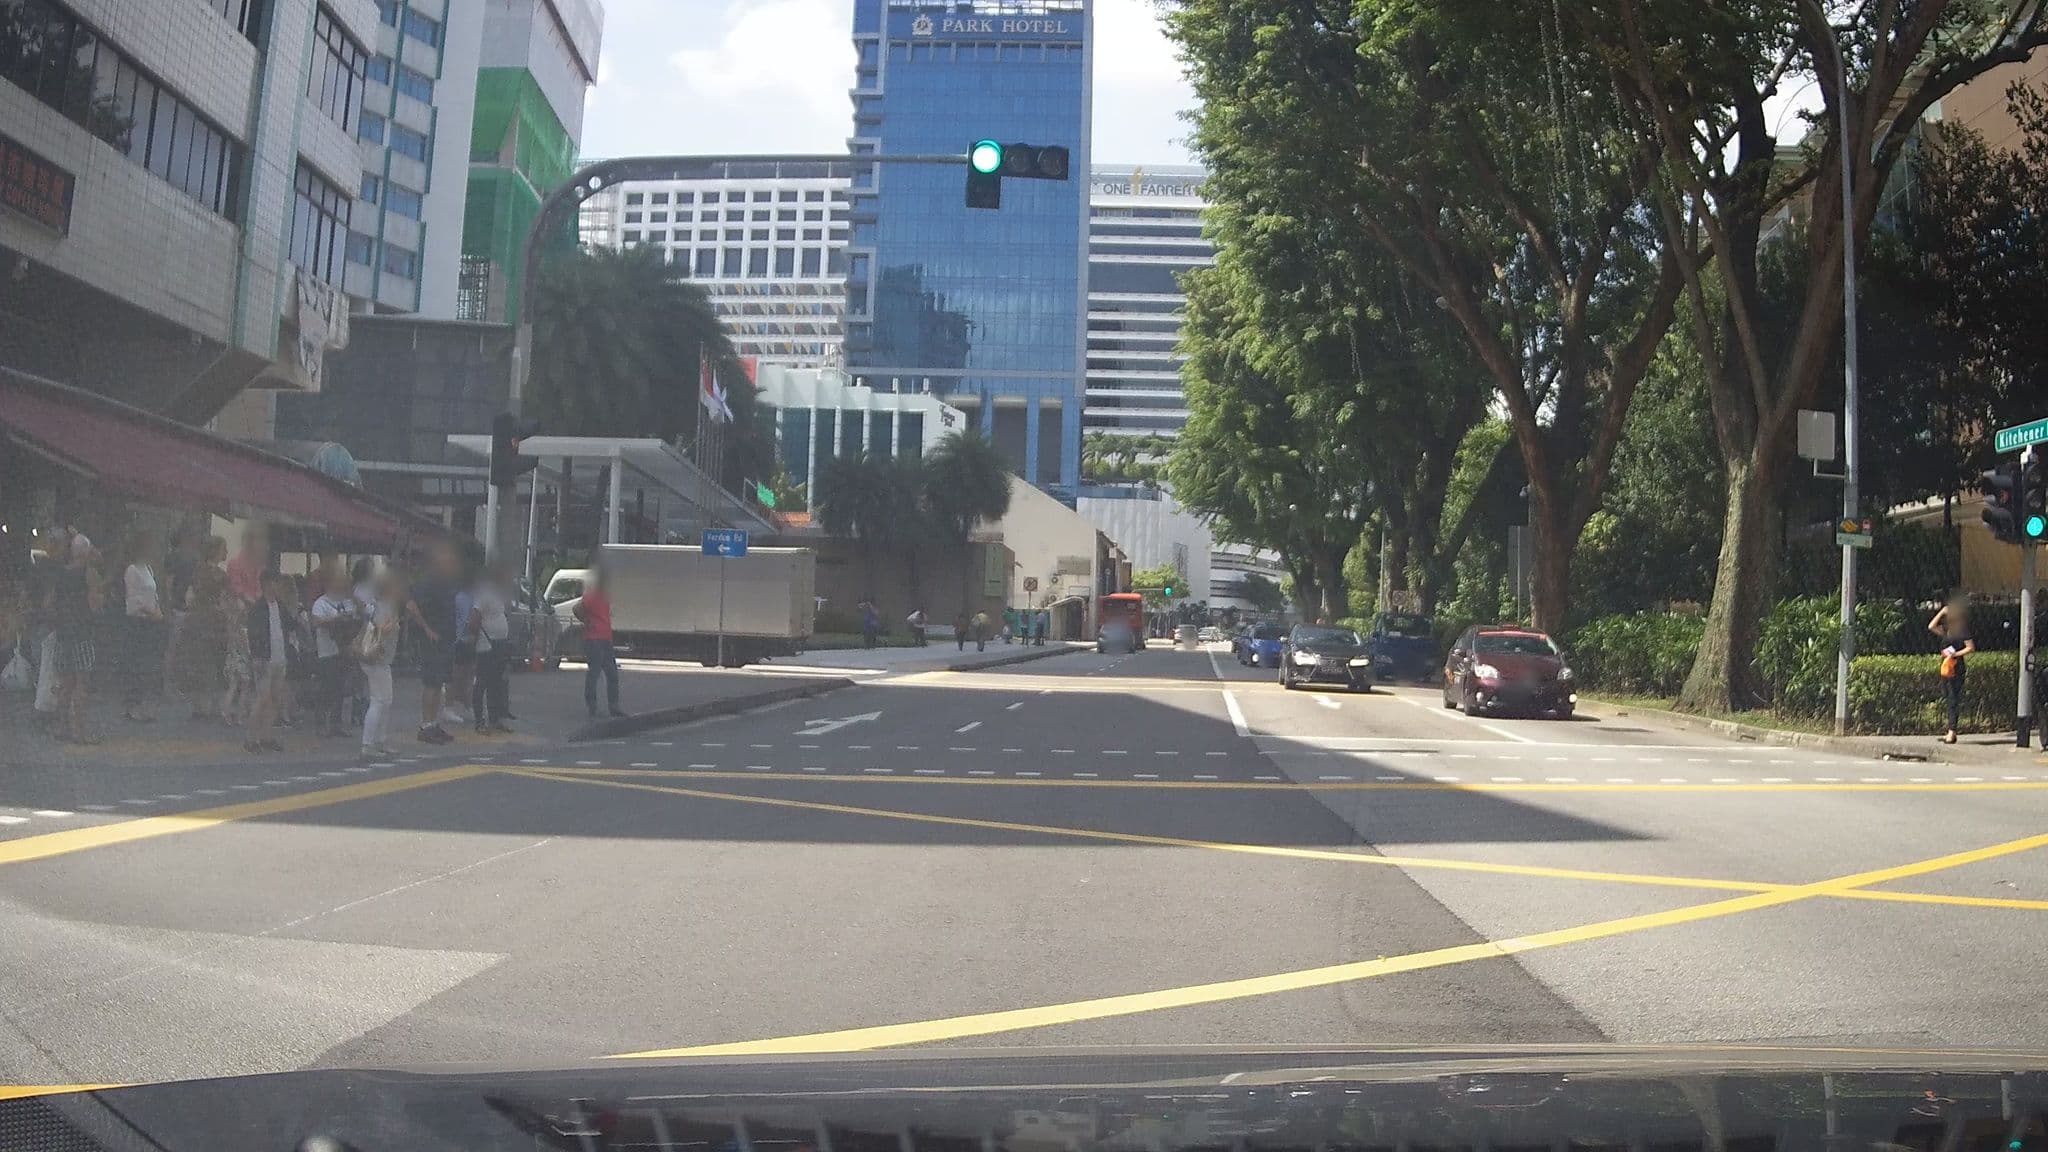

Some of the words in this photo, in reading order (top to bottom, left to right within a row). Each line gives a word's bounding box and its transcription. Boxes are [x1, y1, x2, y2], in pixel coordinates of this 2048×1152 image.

[943, 19, 993, 33] PARK
[1002, 19, 1068, 34] HOTEL
[1103, 183, 1131, 194] ONE
[2000, 427, 2044, 448] Kitchener
